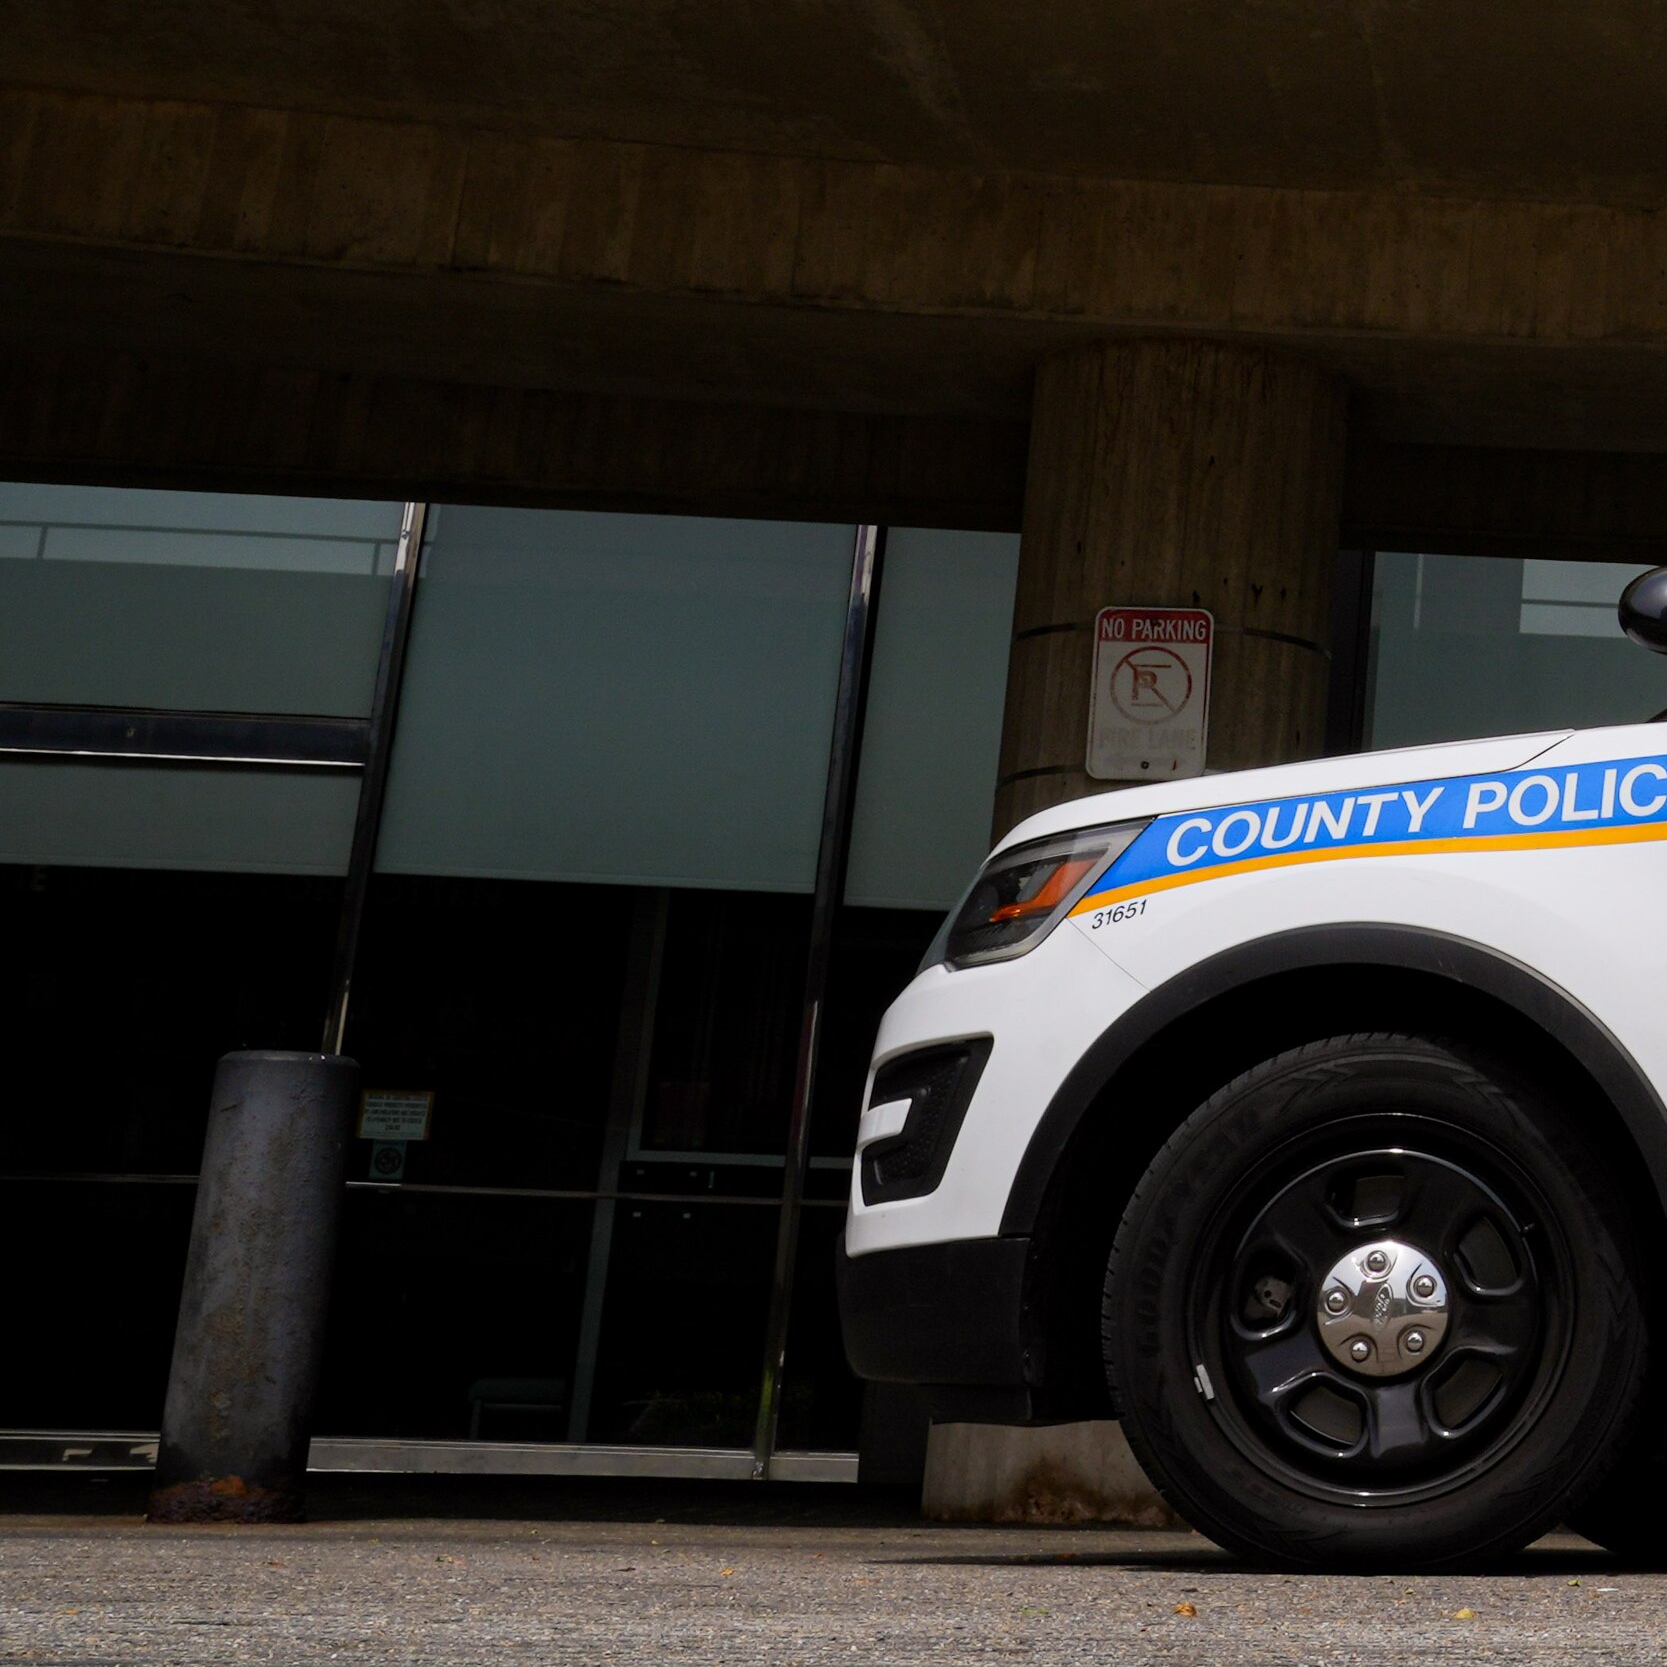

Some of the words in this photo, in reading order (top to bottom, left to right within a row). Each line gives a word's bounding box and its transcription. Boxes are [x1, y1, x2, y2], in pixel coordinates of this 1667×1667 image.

[1102, 618, 1125, 639] NO
[1132, 618, 1206, 641] PARKING
[1166, 787, 1444, 867] COUNTY
[1090, 899, 1148, 930] 31651
